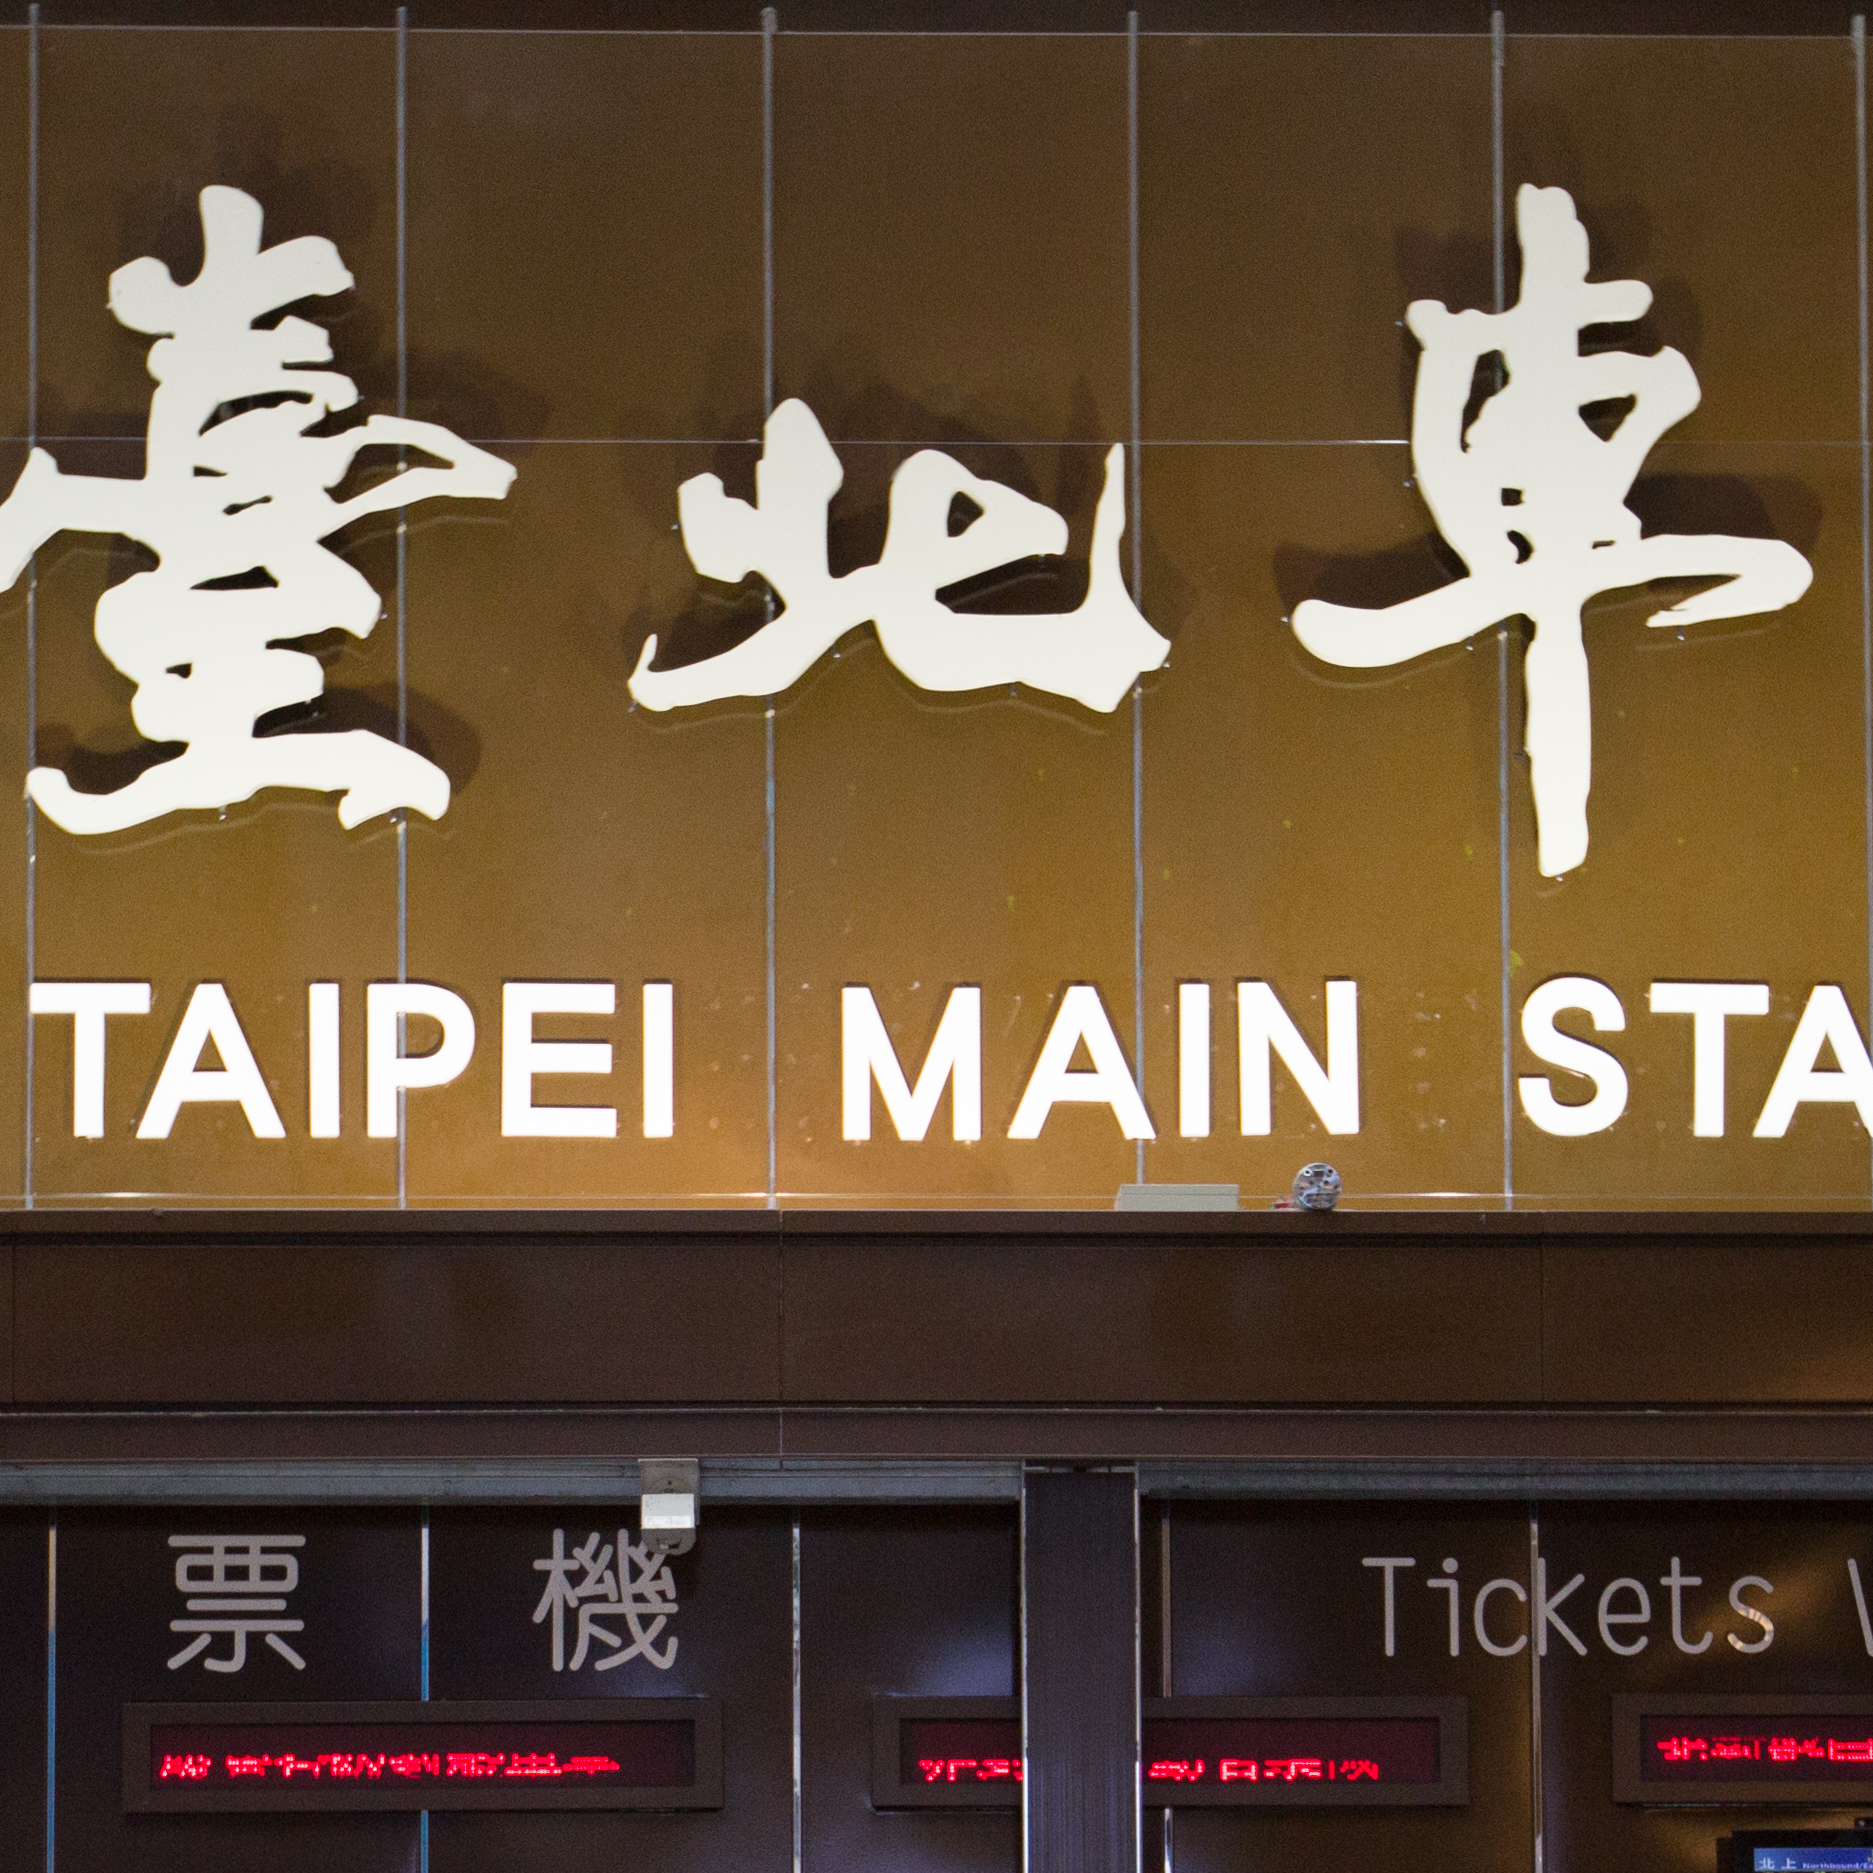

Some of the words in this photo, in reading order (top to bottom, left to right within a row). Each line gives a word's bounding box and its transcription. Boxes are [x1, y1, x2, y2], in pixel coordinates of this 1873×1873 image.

[29, 981, 676, 1143] TAIPEI
[842, 979, 1360, 1143] MAIN
[1362, 1556, 1775, 1657] Tickets
[1759, 1858, 1797, 1869] 北上
